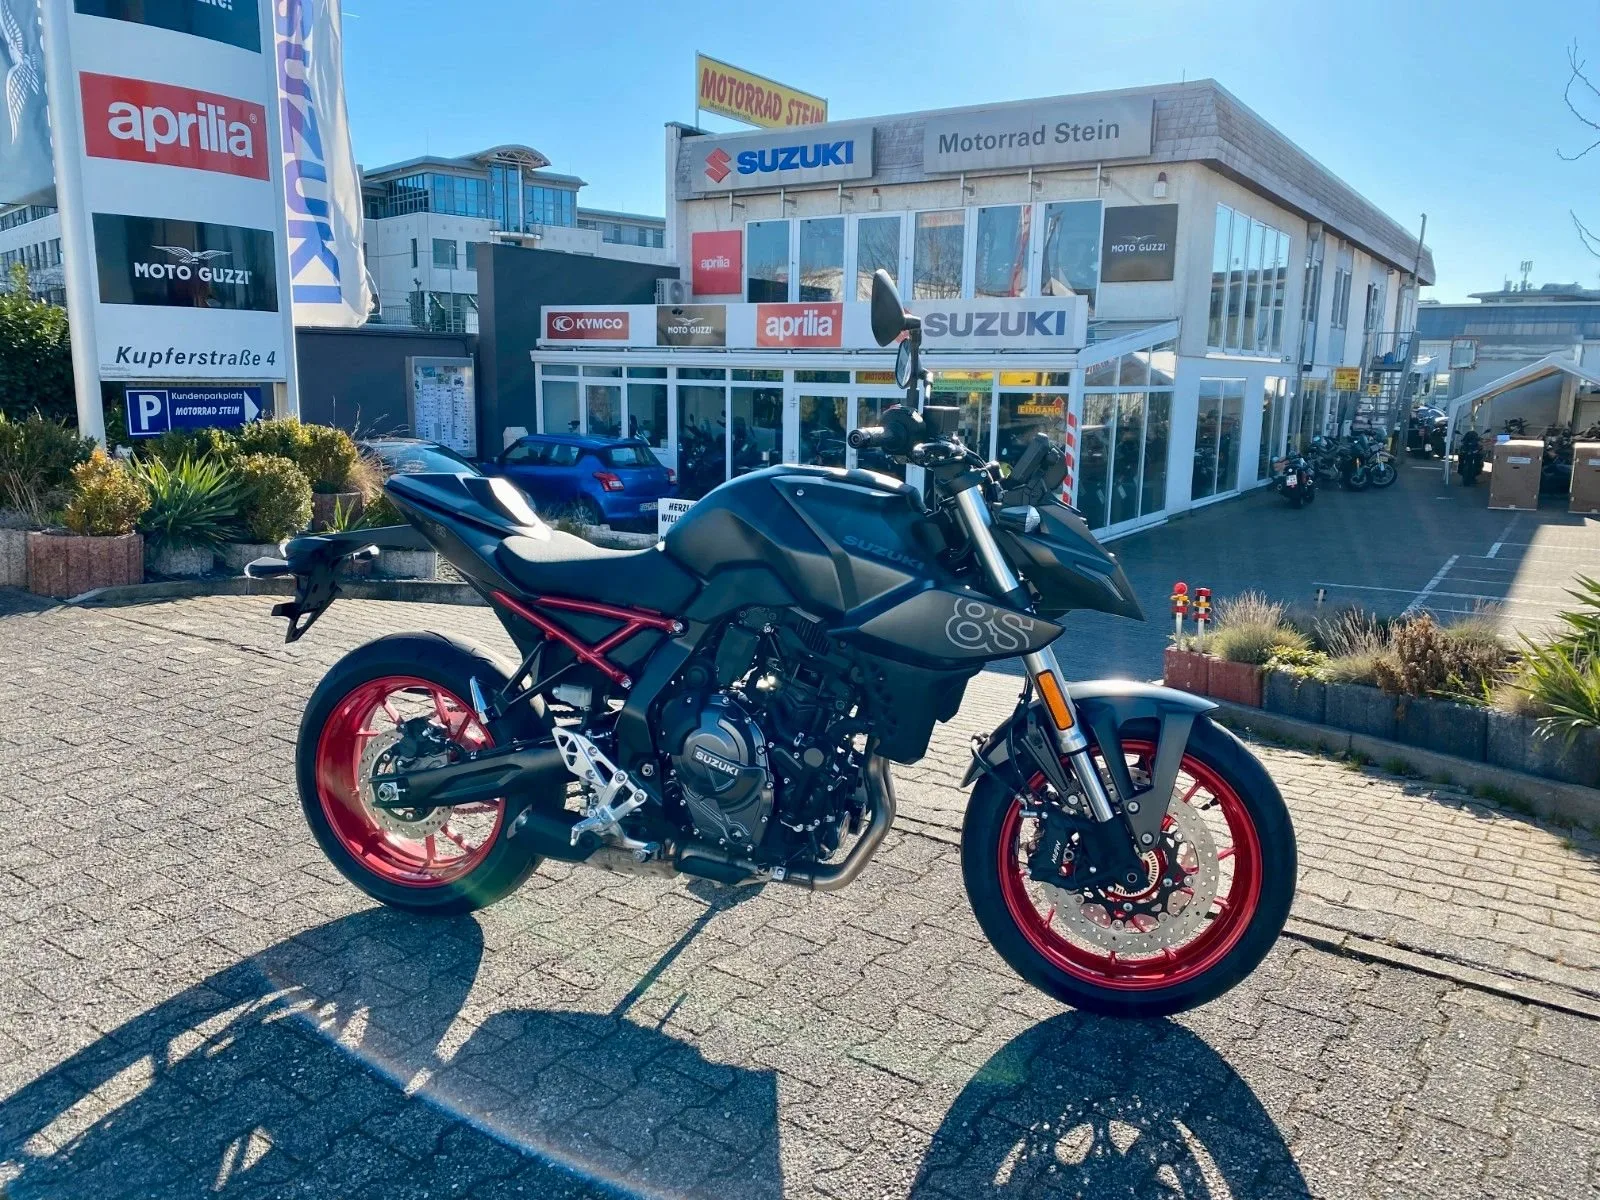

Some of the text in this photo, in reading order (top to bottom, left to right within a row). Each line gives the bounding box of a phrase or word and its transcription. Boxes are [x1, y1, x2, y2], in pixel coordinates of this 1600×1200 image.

[701, 67, 782, 121] MOTORRAD
[938, 119, 1120, 153] Motorrad Stein
[737, 140, 854, 175] SUZUKI
[1111, 243, 1166, 253] MOTO GUZZI
[133, 262, 251, 285] MOTO GUZZI
[701, 256, 730, 270] aprilia
[576, 318, 623, 330] KYMCO
[667, 326, 712, 334] MOTO GUZZI
[765, 309, 833, 341] aprilia
[923, 310, 1067, 338] SUZUKI
[115, 346, 276, 369] Kupferstraße 4
[171, 392, 243, 401] Kundenparkplatz
[138, 394, 162, 431] P
[175, 406, 240, 416] MOTORRAD STEIN
[1020, 406, 1062, 414] EINGANG
[842, 535, 925, 571] SUZUKI
[695, 751, 739, 776] SUZUKI
